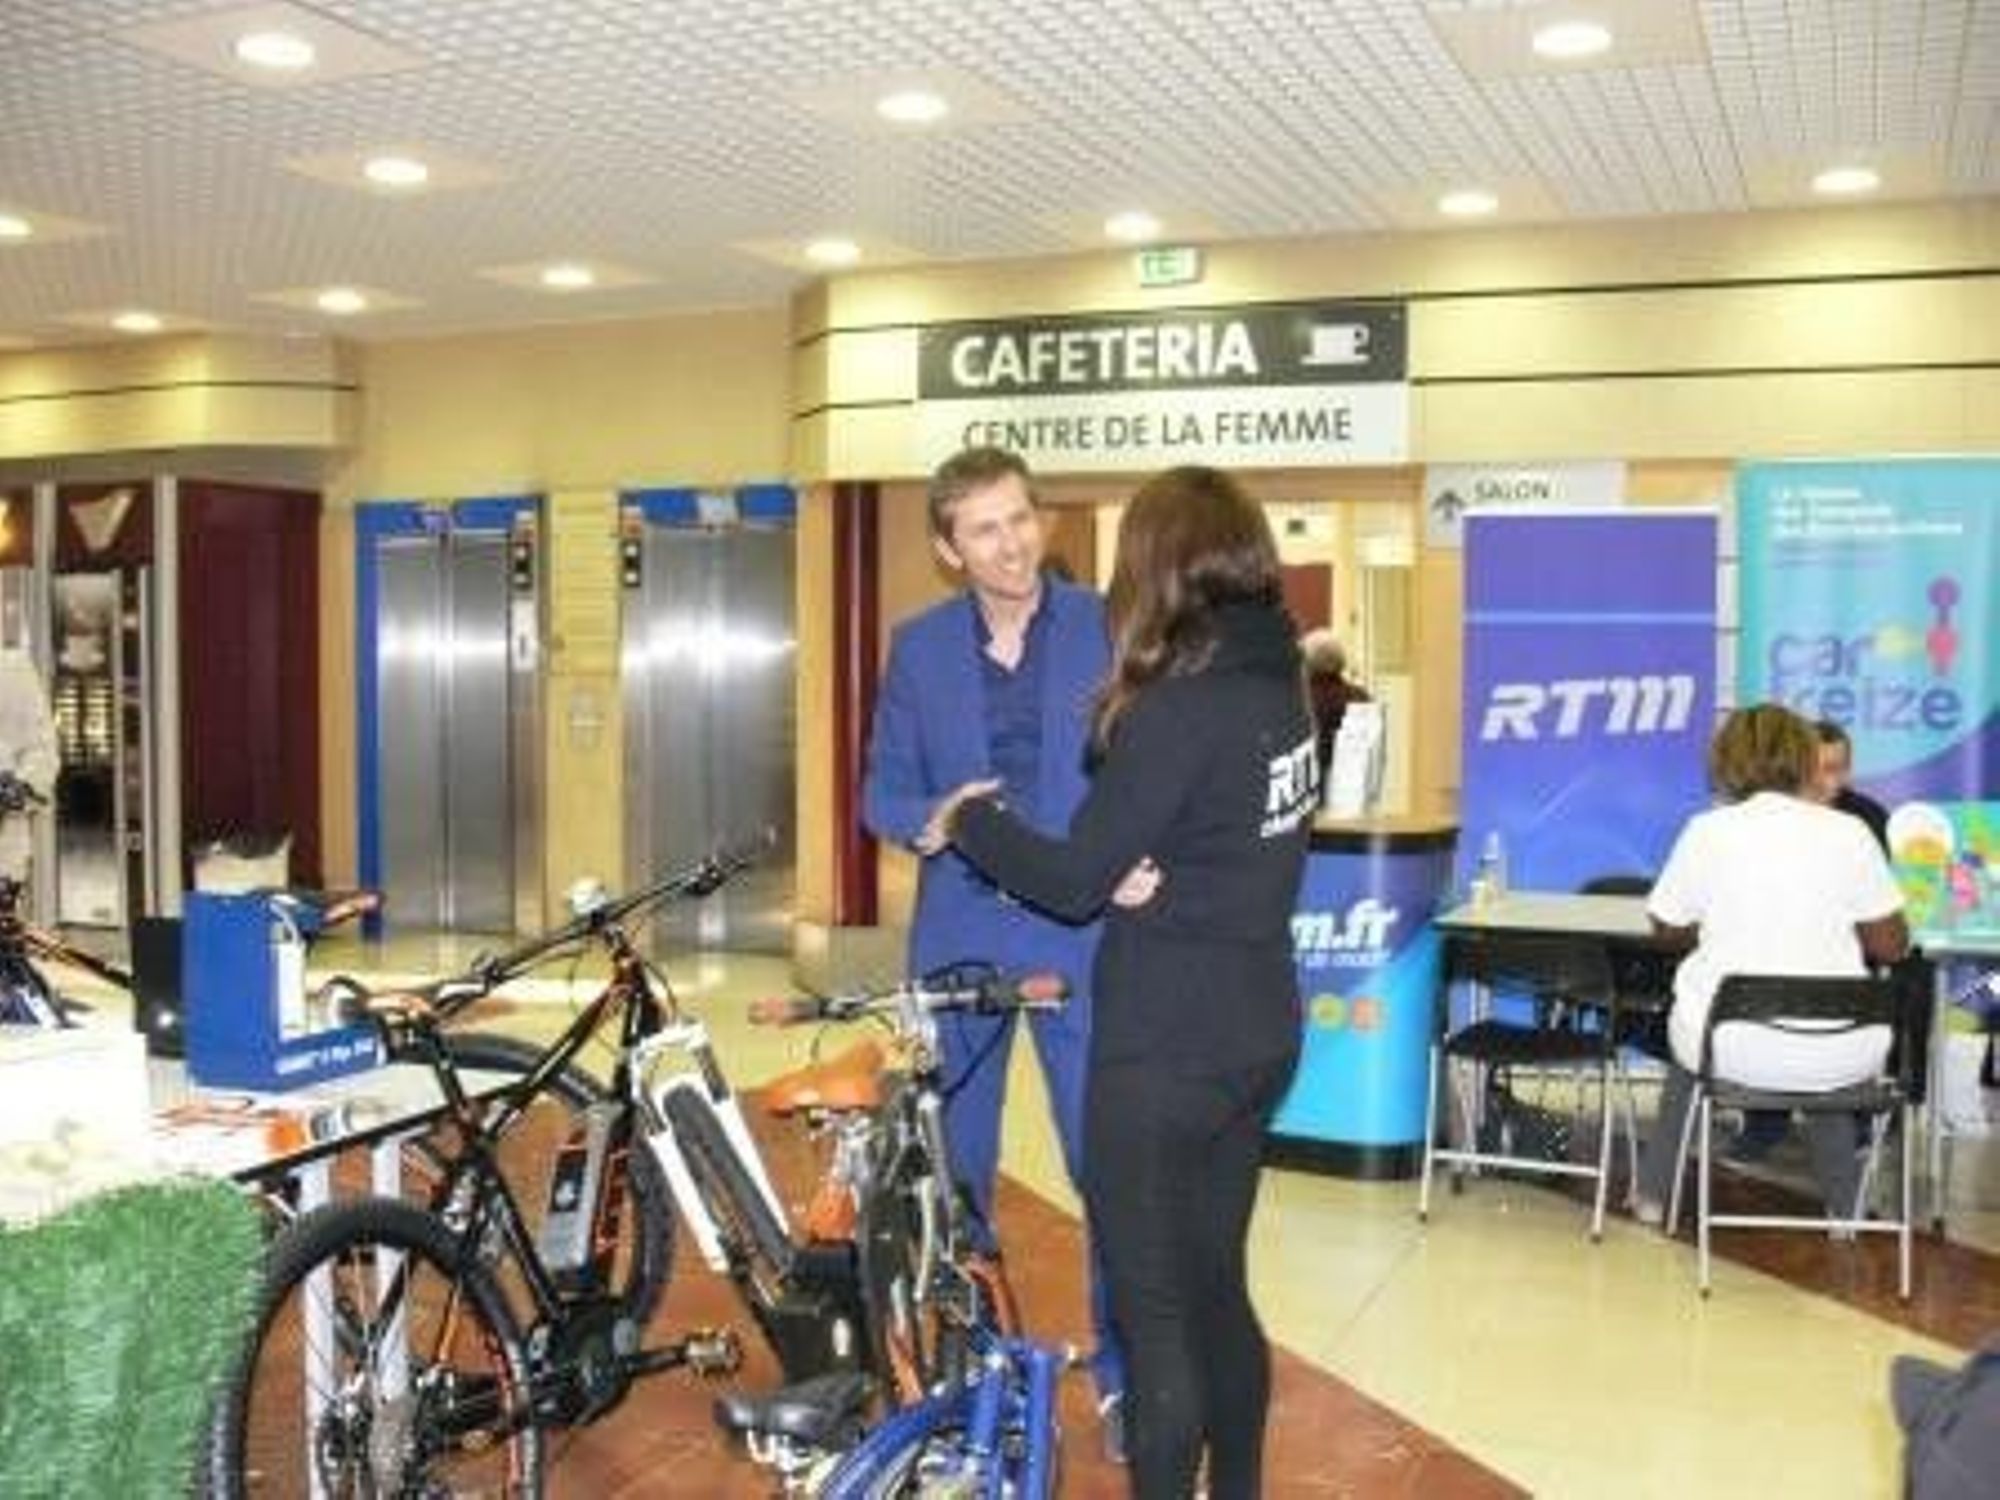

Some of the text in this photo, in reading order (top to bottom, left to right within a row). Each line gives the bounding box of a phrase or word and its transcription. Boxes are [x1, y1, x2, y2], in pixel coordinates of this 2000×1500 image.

[951, 321, 1259, 387] CAFETERIA
[1104, 413, 1151, 447] DE
[1161, 413, 1204, 446] LA
[1214, 406, 1353, 445] FEMME
